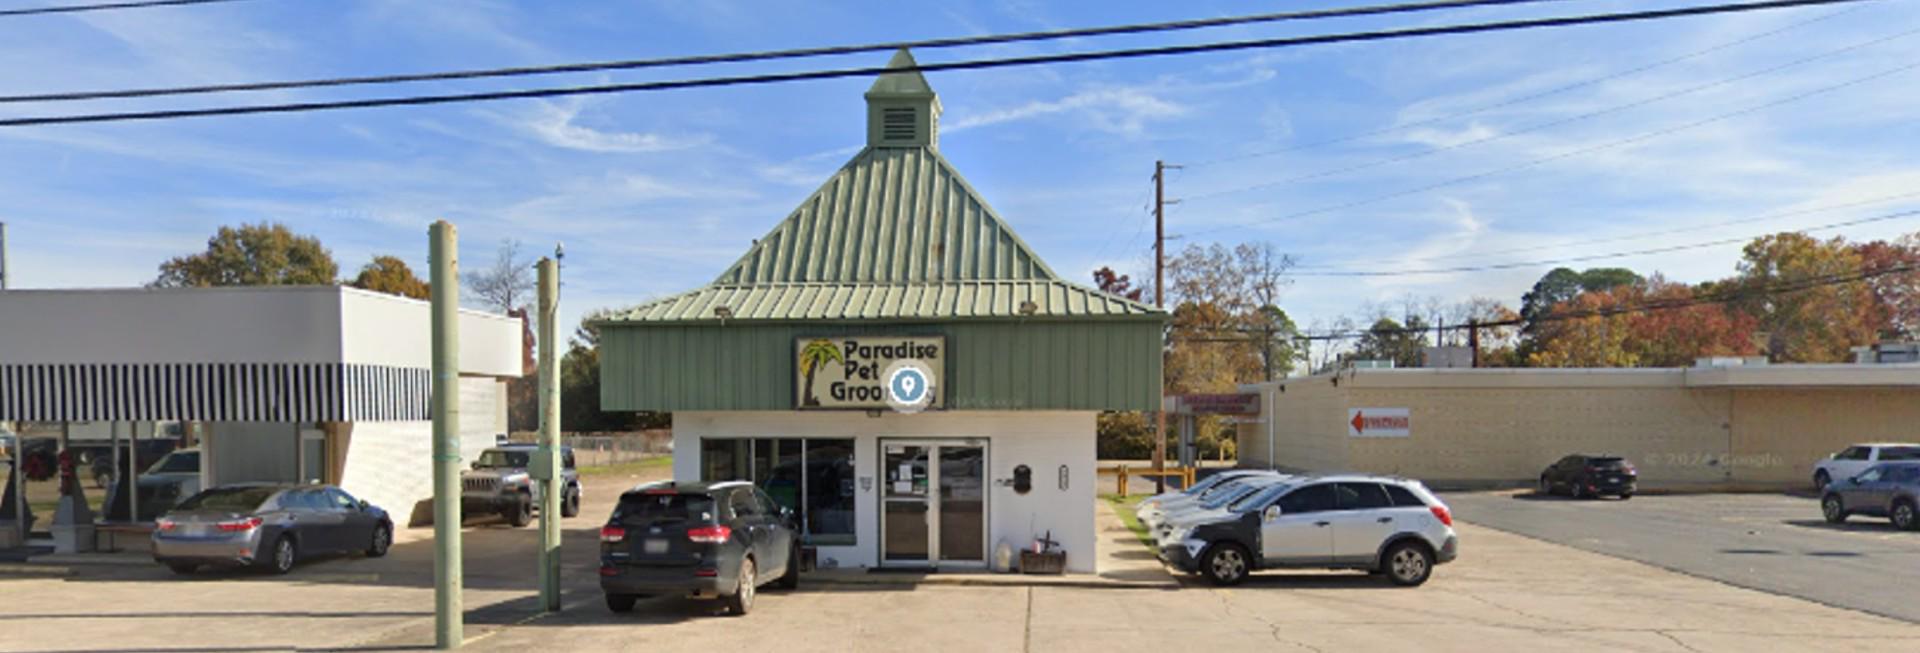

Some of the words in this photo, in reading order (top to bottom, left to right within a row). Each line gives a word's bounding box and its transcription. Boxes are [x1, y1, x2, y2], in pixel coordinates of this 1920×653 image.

[844, 340, 938, 359] Paradise
[844, 360, 879, 380] Pet
[830, 381, 937, 404] Groog
